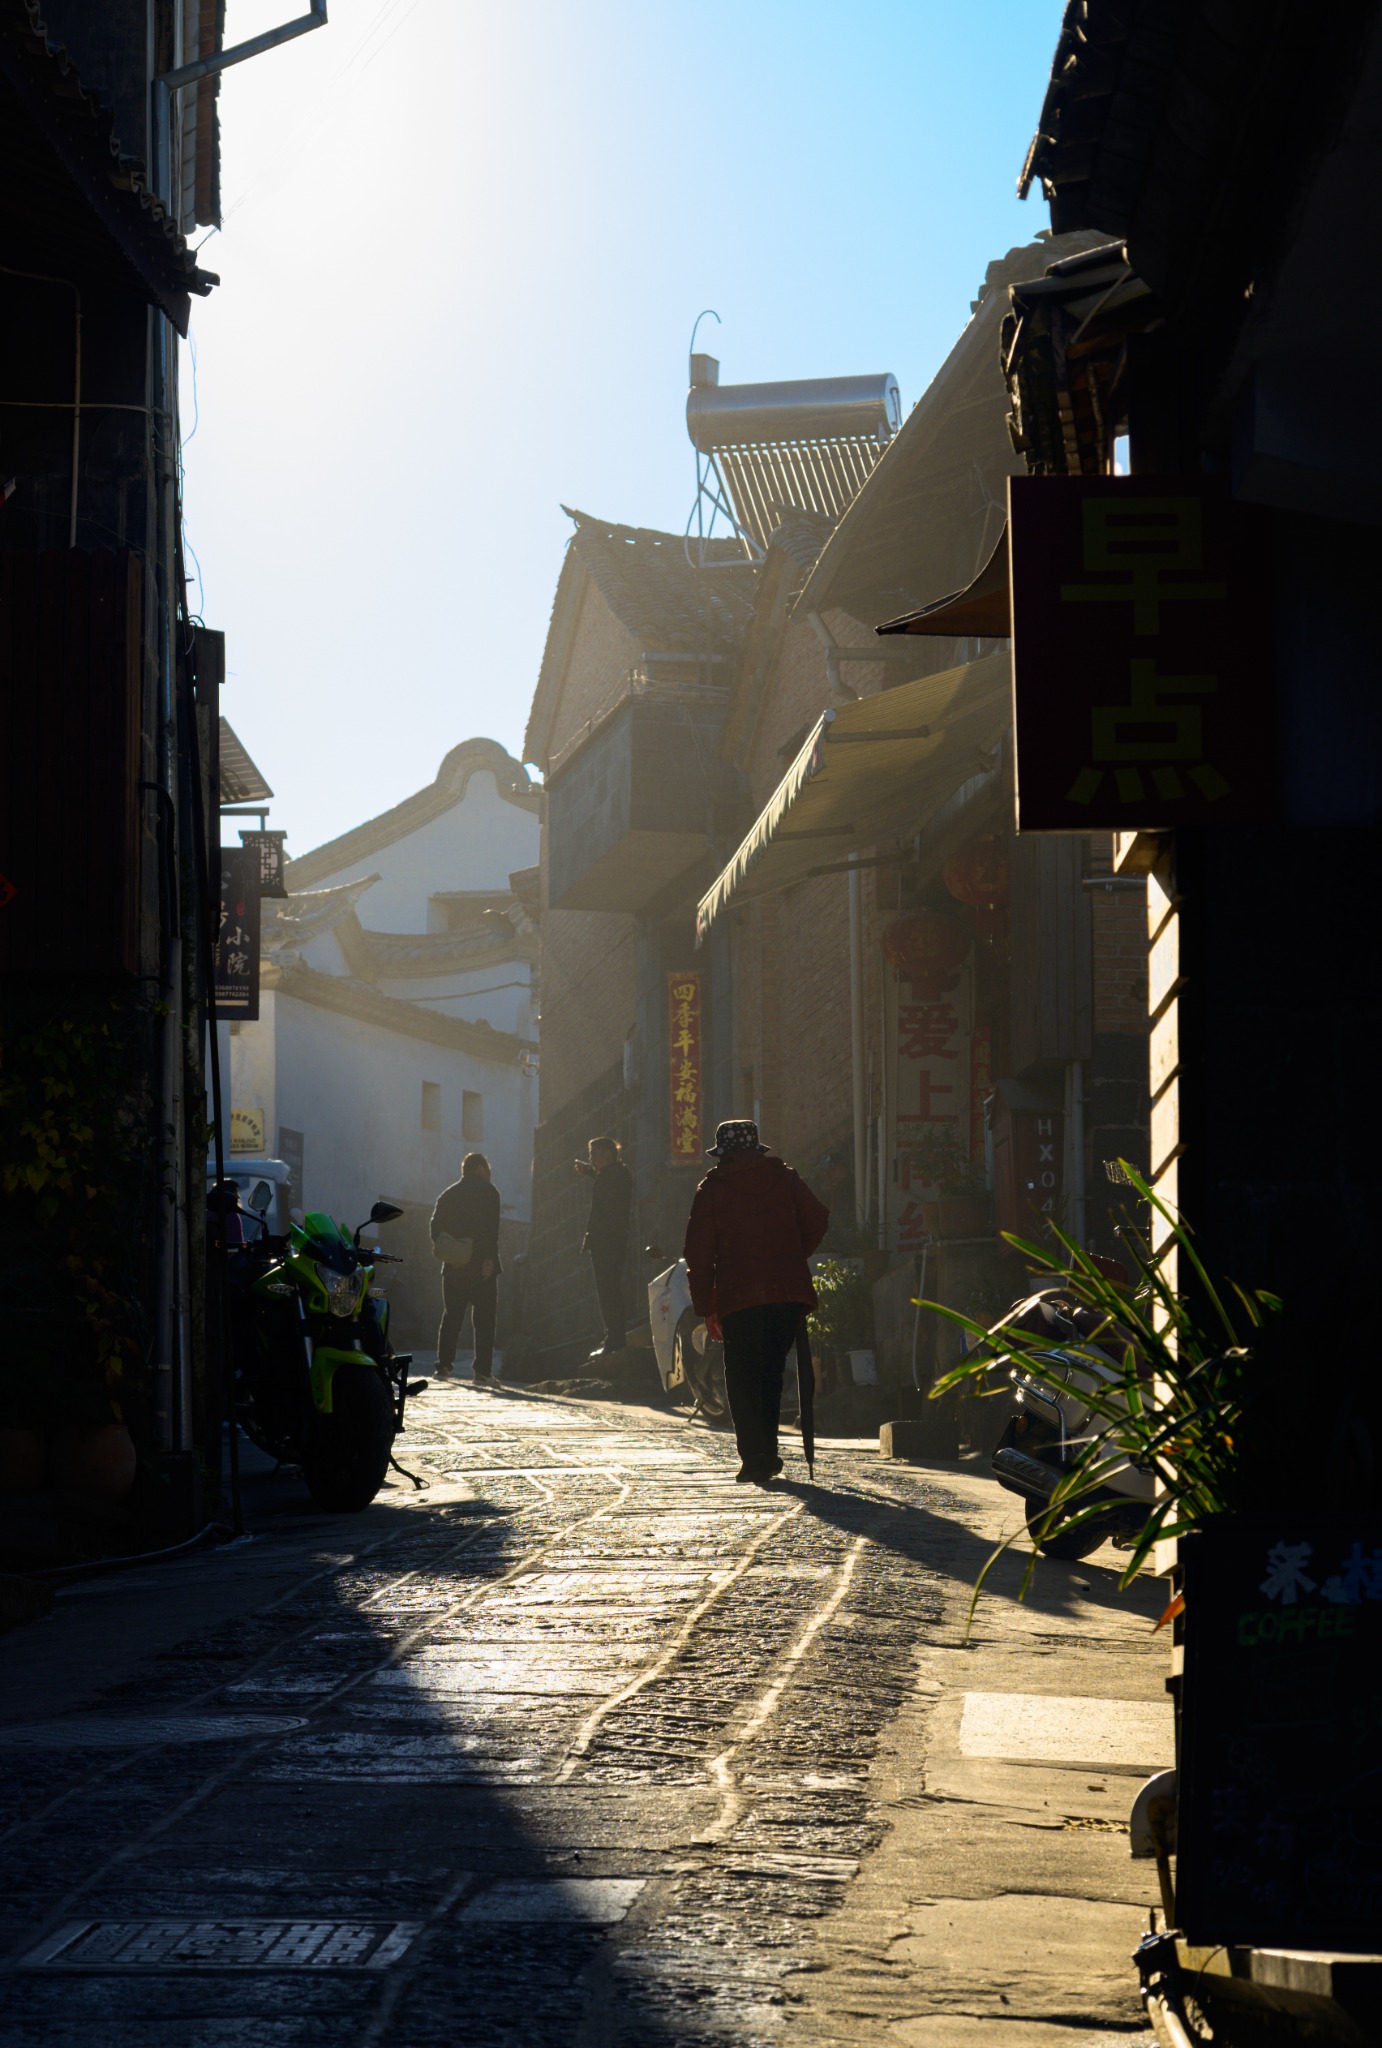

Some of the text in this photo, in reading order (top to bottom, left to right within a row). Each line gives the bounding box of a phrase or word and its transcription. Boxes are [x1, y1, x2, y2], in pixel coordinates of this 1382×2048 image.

[1060, 496, 1232, 805] 早点
[673, 983, 699, 1153] 四季平安福满堂
[1237, 1607, 1358, 1647] COFFEE
